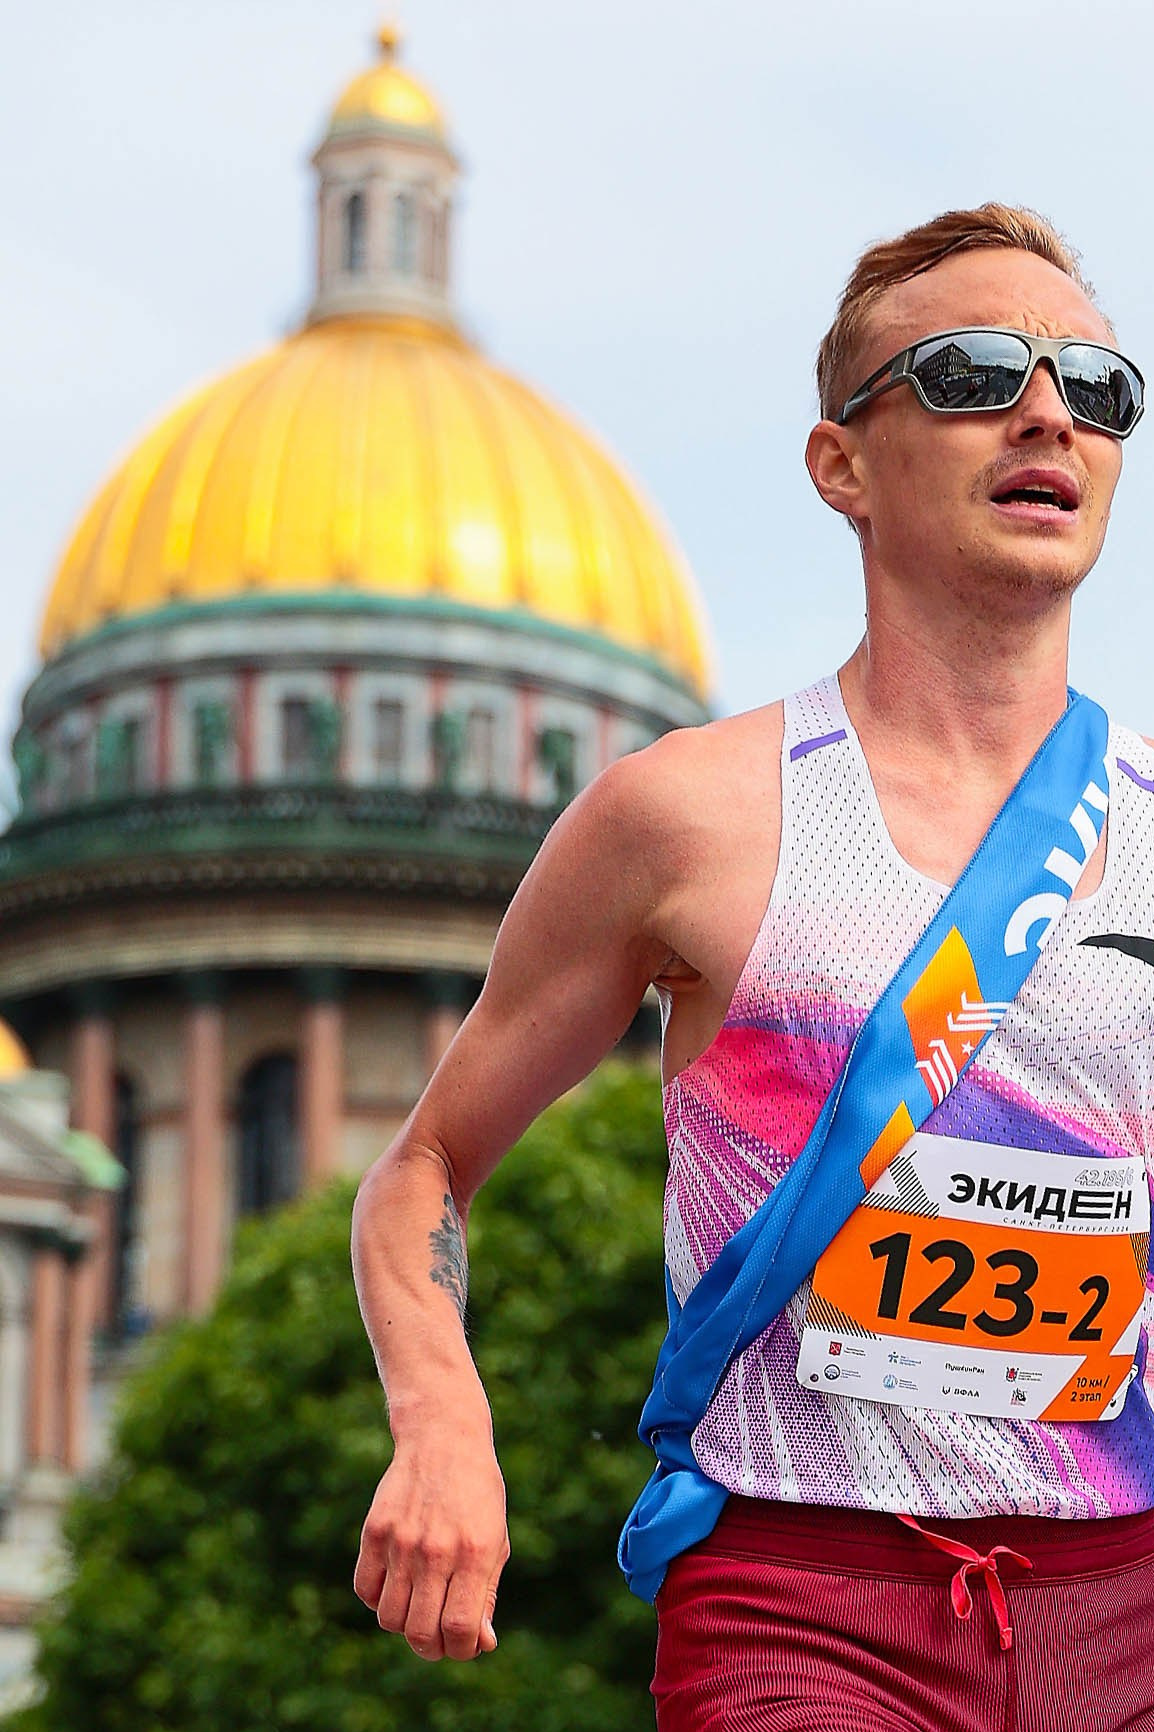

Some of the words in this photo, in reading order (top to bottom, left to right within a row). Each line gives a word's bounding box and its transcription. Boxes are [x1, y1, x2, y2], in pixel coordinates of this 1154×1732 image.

[947, 1173, 1132, 1222] ЭКИДЕН
[1003, 1217, 1109, 1233] САНКТ-ПЕТЕРБУРГ
[869, 1232, 1110, 1342] 123-2
[1077, 1377, 1088, 1388] 10
[1070, 1391, 1078, 1402] 2
[1079, 1392, 1102, 1402] этап
